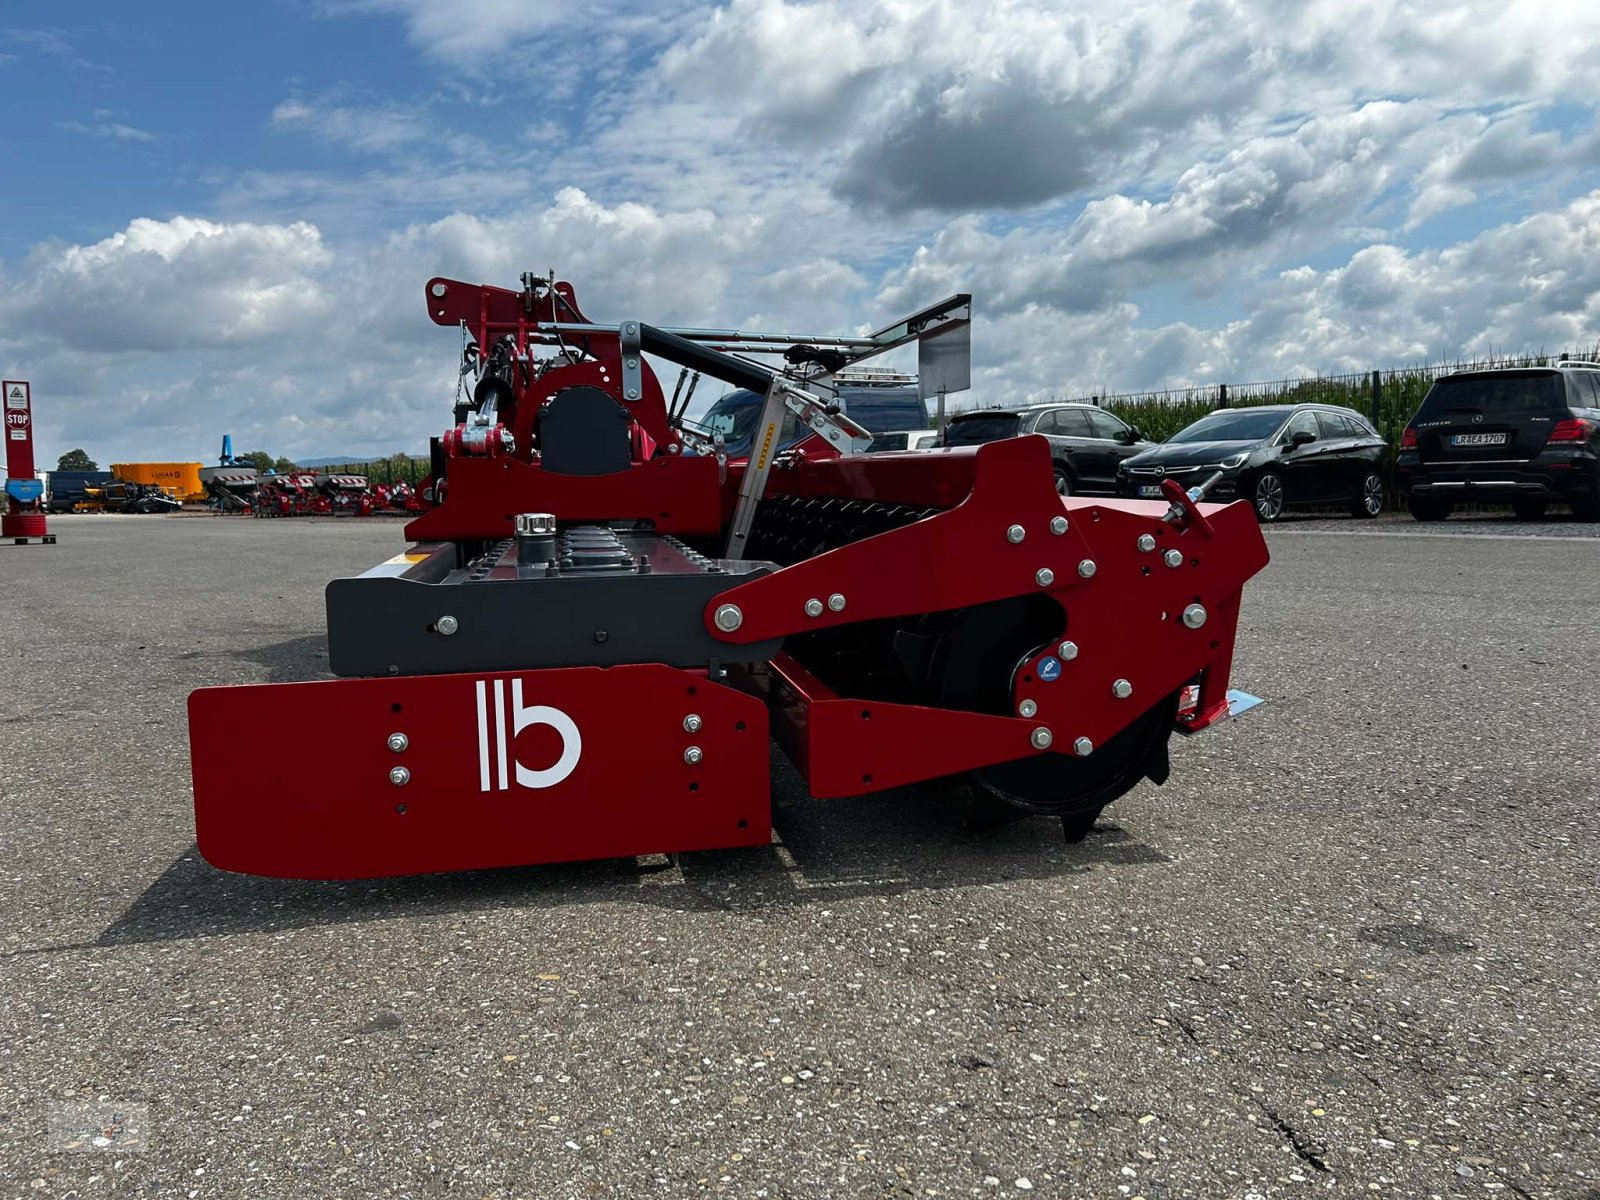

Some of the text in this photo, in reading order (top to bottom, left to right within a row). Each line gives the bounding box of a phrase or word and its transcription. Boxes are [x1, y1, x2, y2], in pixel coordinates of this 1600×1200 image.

[7, 414, 28, 424] STOP
[1455, 433, 1505, 444] LR EA 1707
